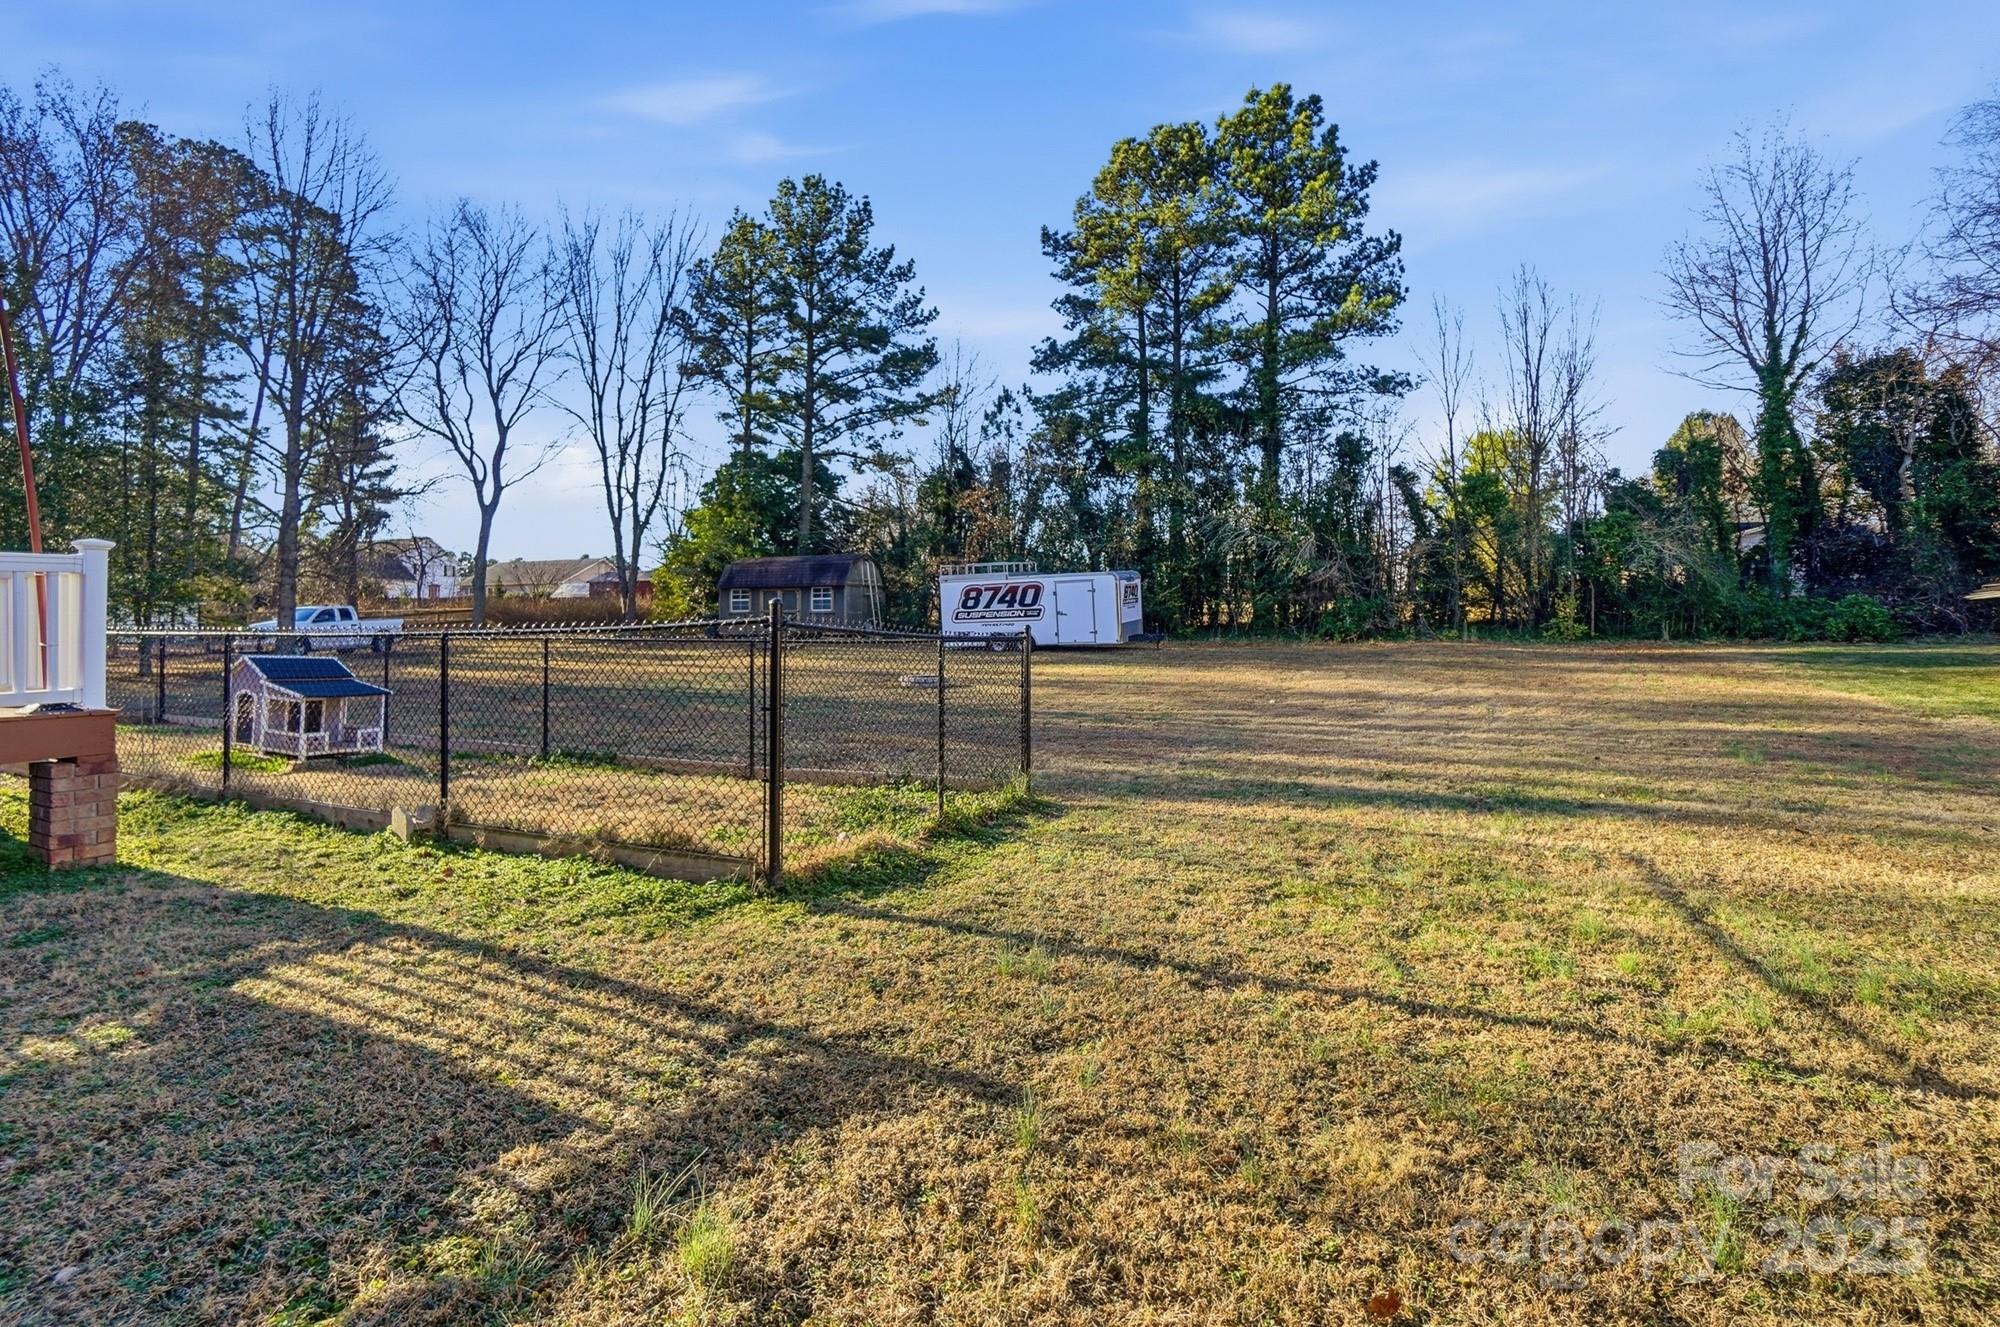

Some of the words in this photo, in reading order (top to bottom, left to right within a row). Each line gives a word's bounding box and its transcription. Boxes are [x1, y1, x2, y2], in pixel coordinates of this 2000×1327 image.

[961, 584, 1041, 609] 8740
[1123, 584, 1138, 598] 8740
[957, 610, 1025, 619] SUSPENSION
